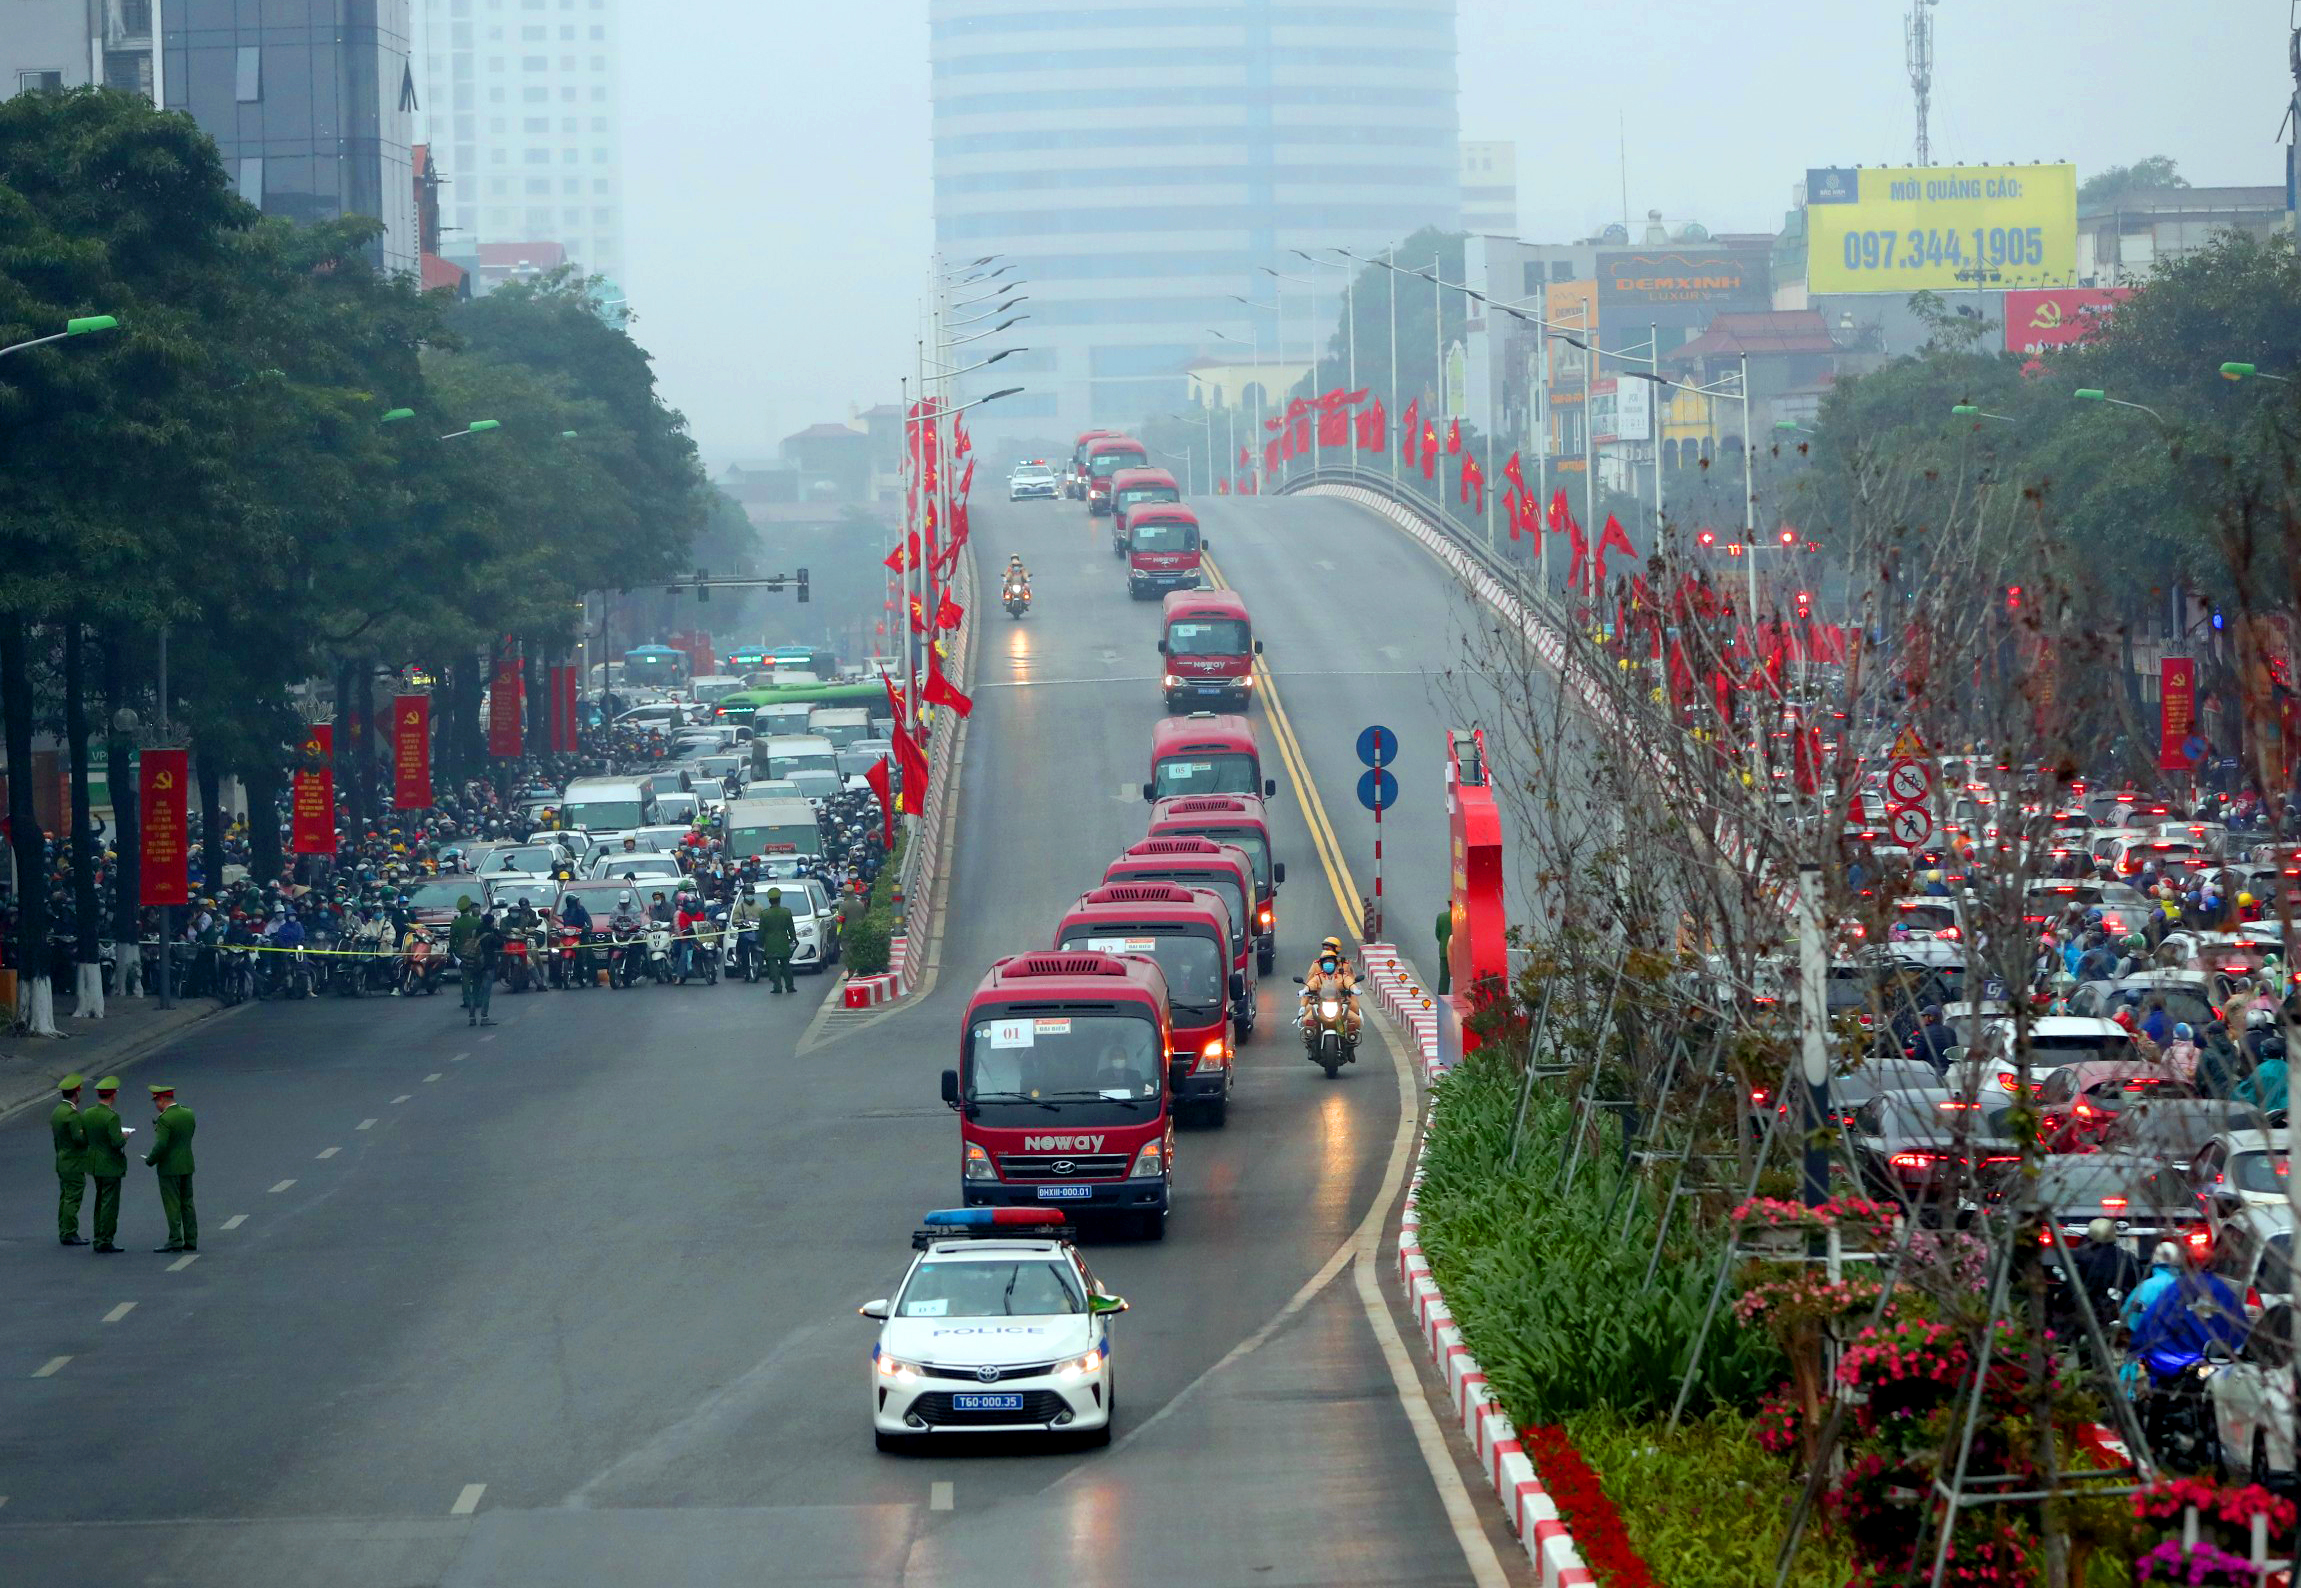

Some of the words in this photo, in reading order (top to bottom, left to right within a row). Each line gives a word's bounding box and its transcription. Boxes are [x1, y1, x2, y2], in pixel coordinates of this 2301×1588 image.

[1926, 173, 1981, 202] QUẢNG
[1843, 227, 2043, 270] 097.344.1905
[1003, 1027, 1020, 1040] 01
[933, 1327, 1045, 1337] POLICE
[959, 1396, 1018, 1408] T60-000.35
